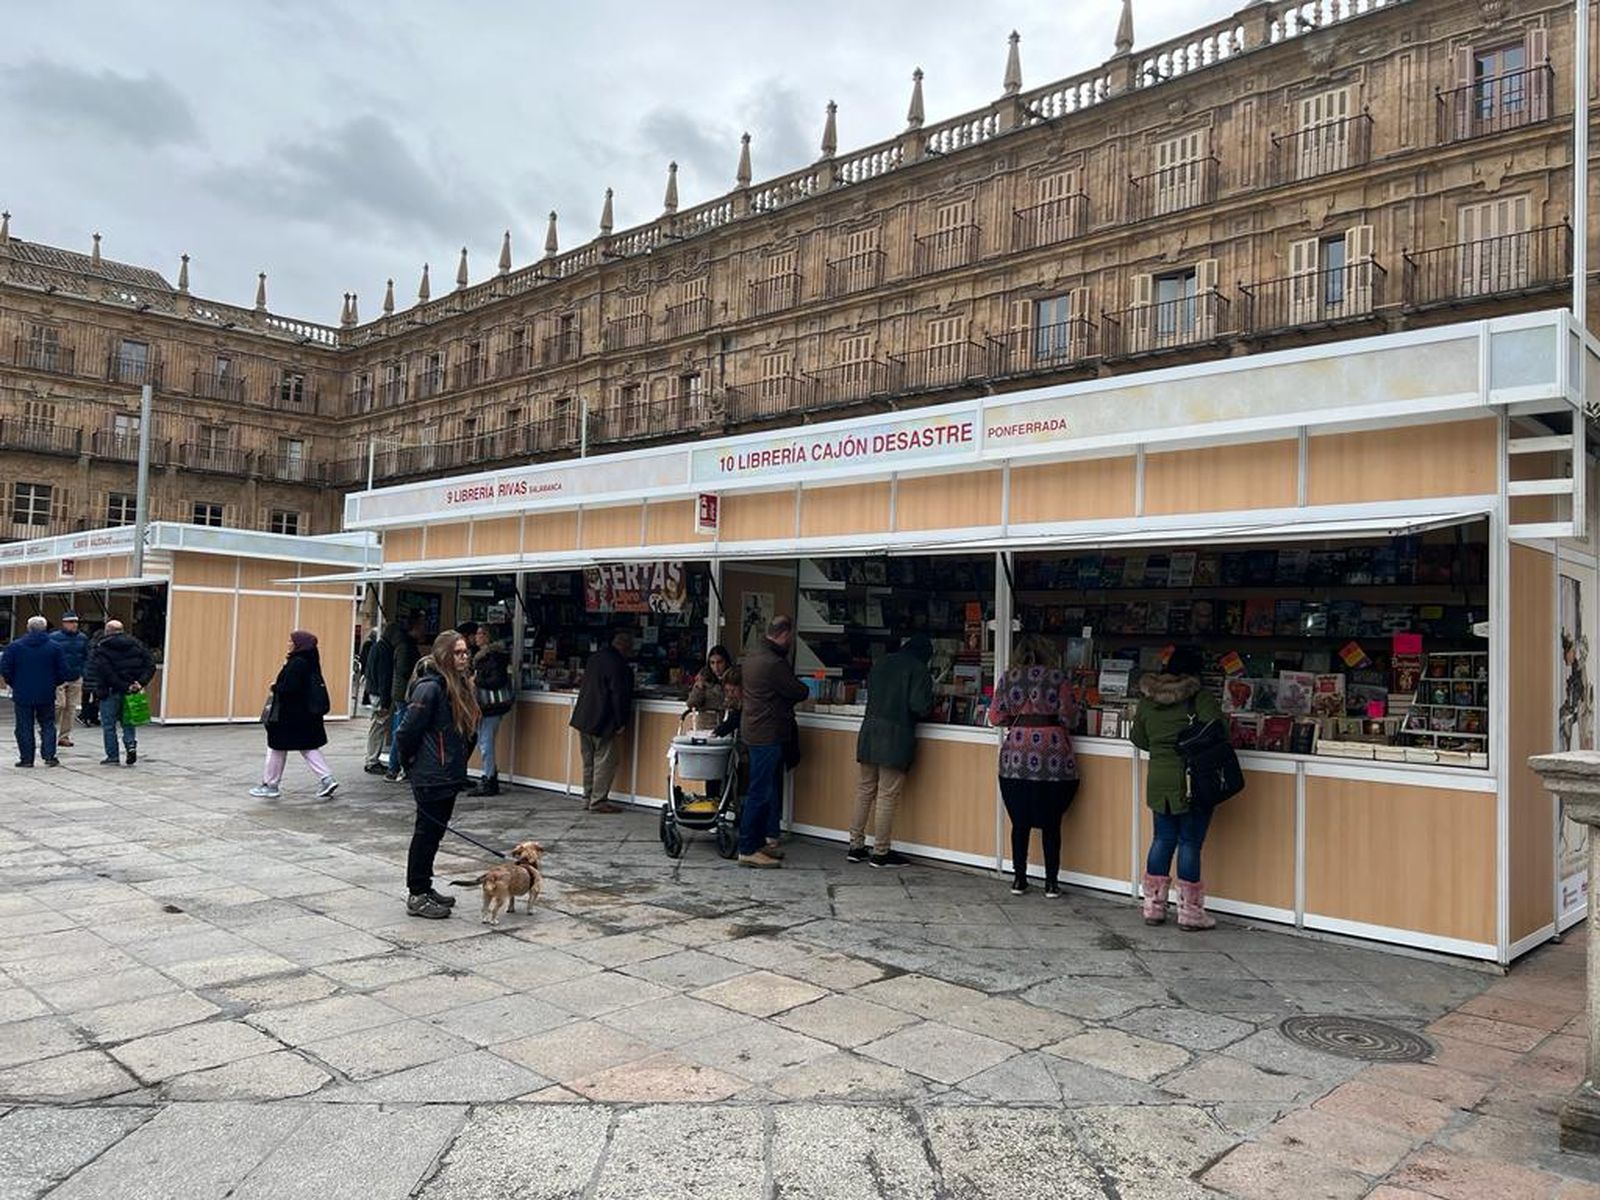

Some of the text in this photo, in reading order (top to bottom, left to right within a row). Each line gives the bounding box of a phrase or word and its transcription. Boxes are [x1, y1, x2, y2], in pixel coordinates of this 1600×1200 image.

[719, 418, 1067, 472] 10 LIBRERÍA CAJÓN DESASTRE PONFERRADA
[447, 491, 453, 504] 9
[498, 480, 527, 497] RIVAS
